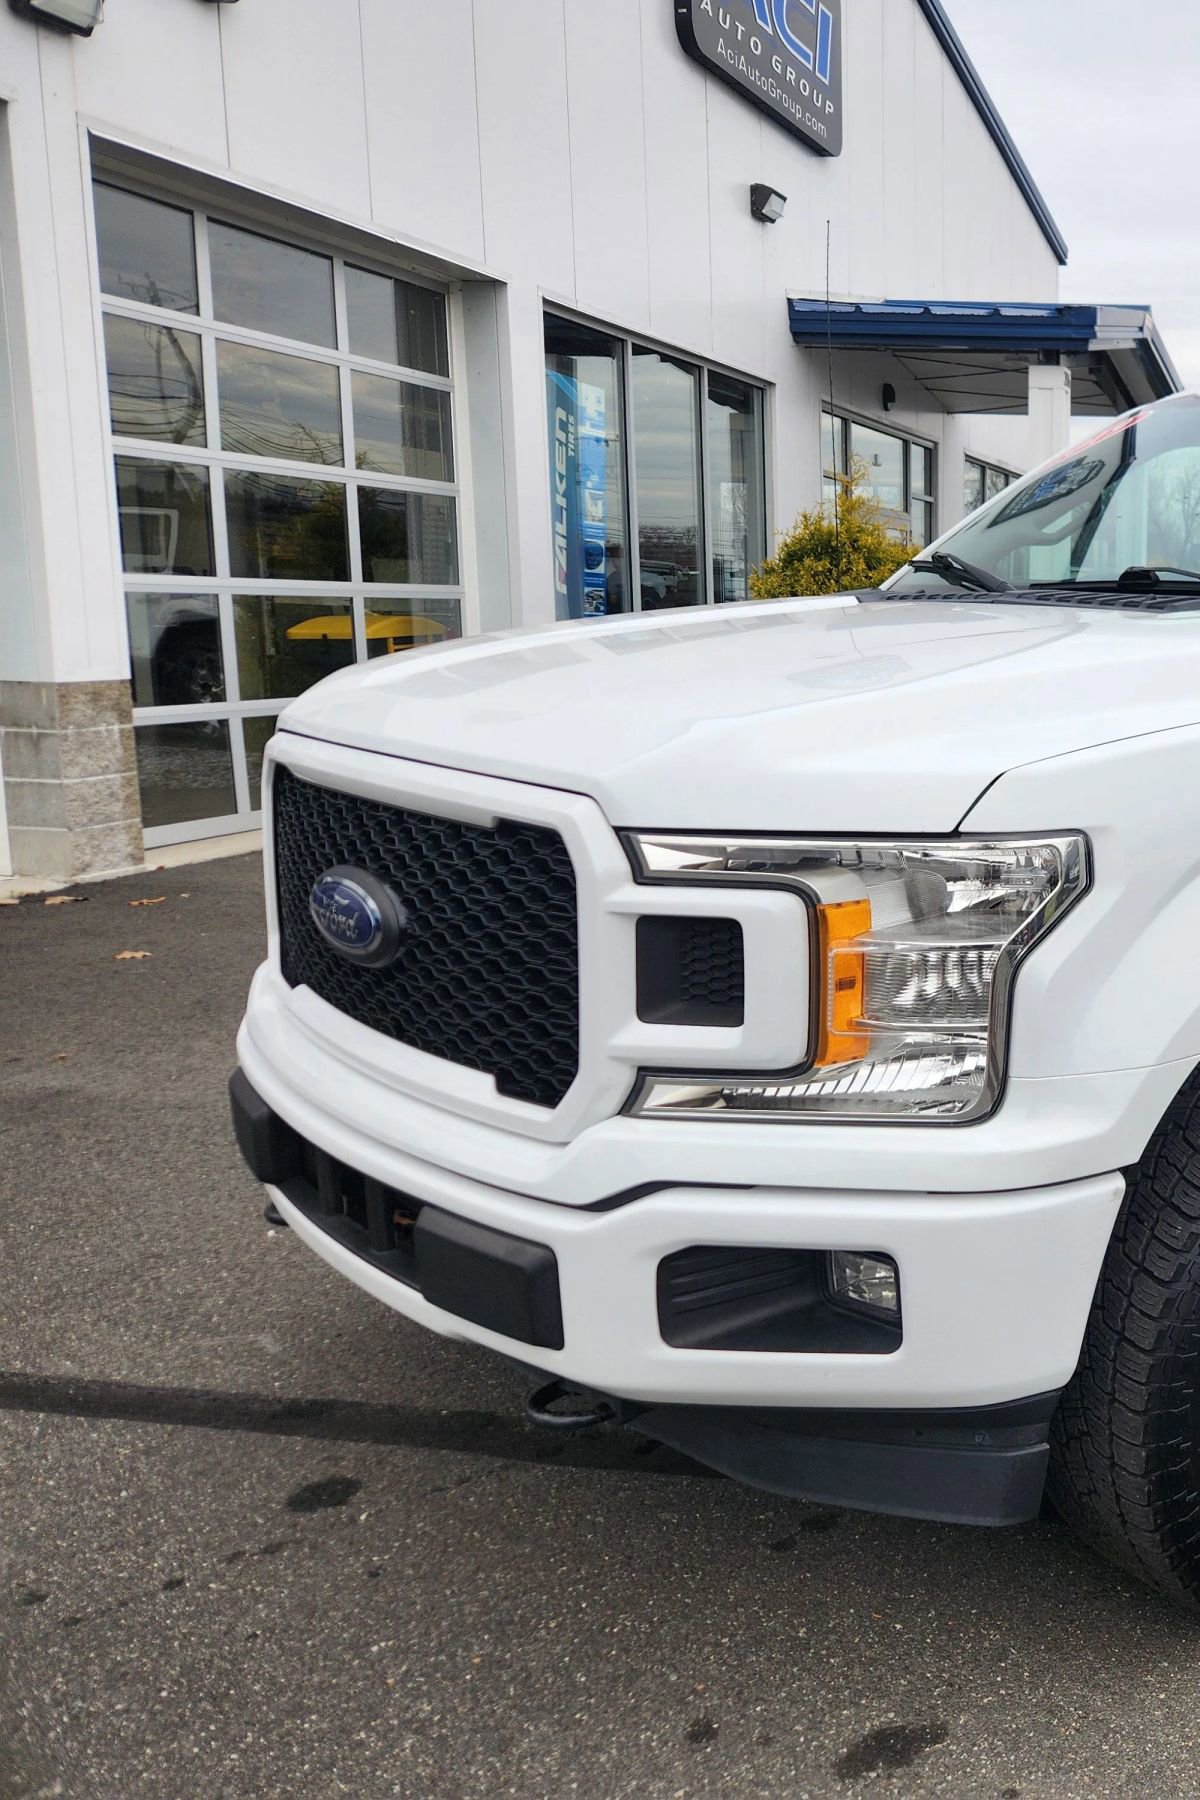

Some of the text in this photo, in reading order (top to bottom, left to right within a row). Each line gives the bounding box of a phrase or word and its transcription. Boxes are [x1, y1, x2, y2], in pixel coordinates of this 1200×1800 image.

[700, 0, 834, 114] AUTO GROUP
[717, 38, 827, 139] AciAutoGroup.com
[752, 0, 832, 85] CI
[555, 406, 568, 594] FALKEN
